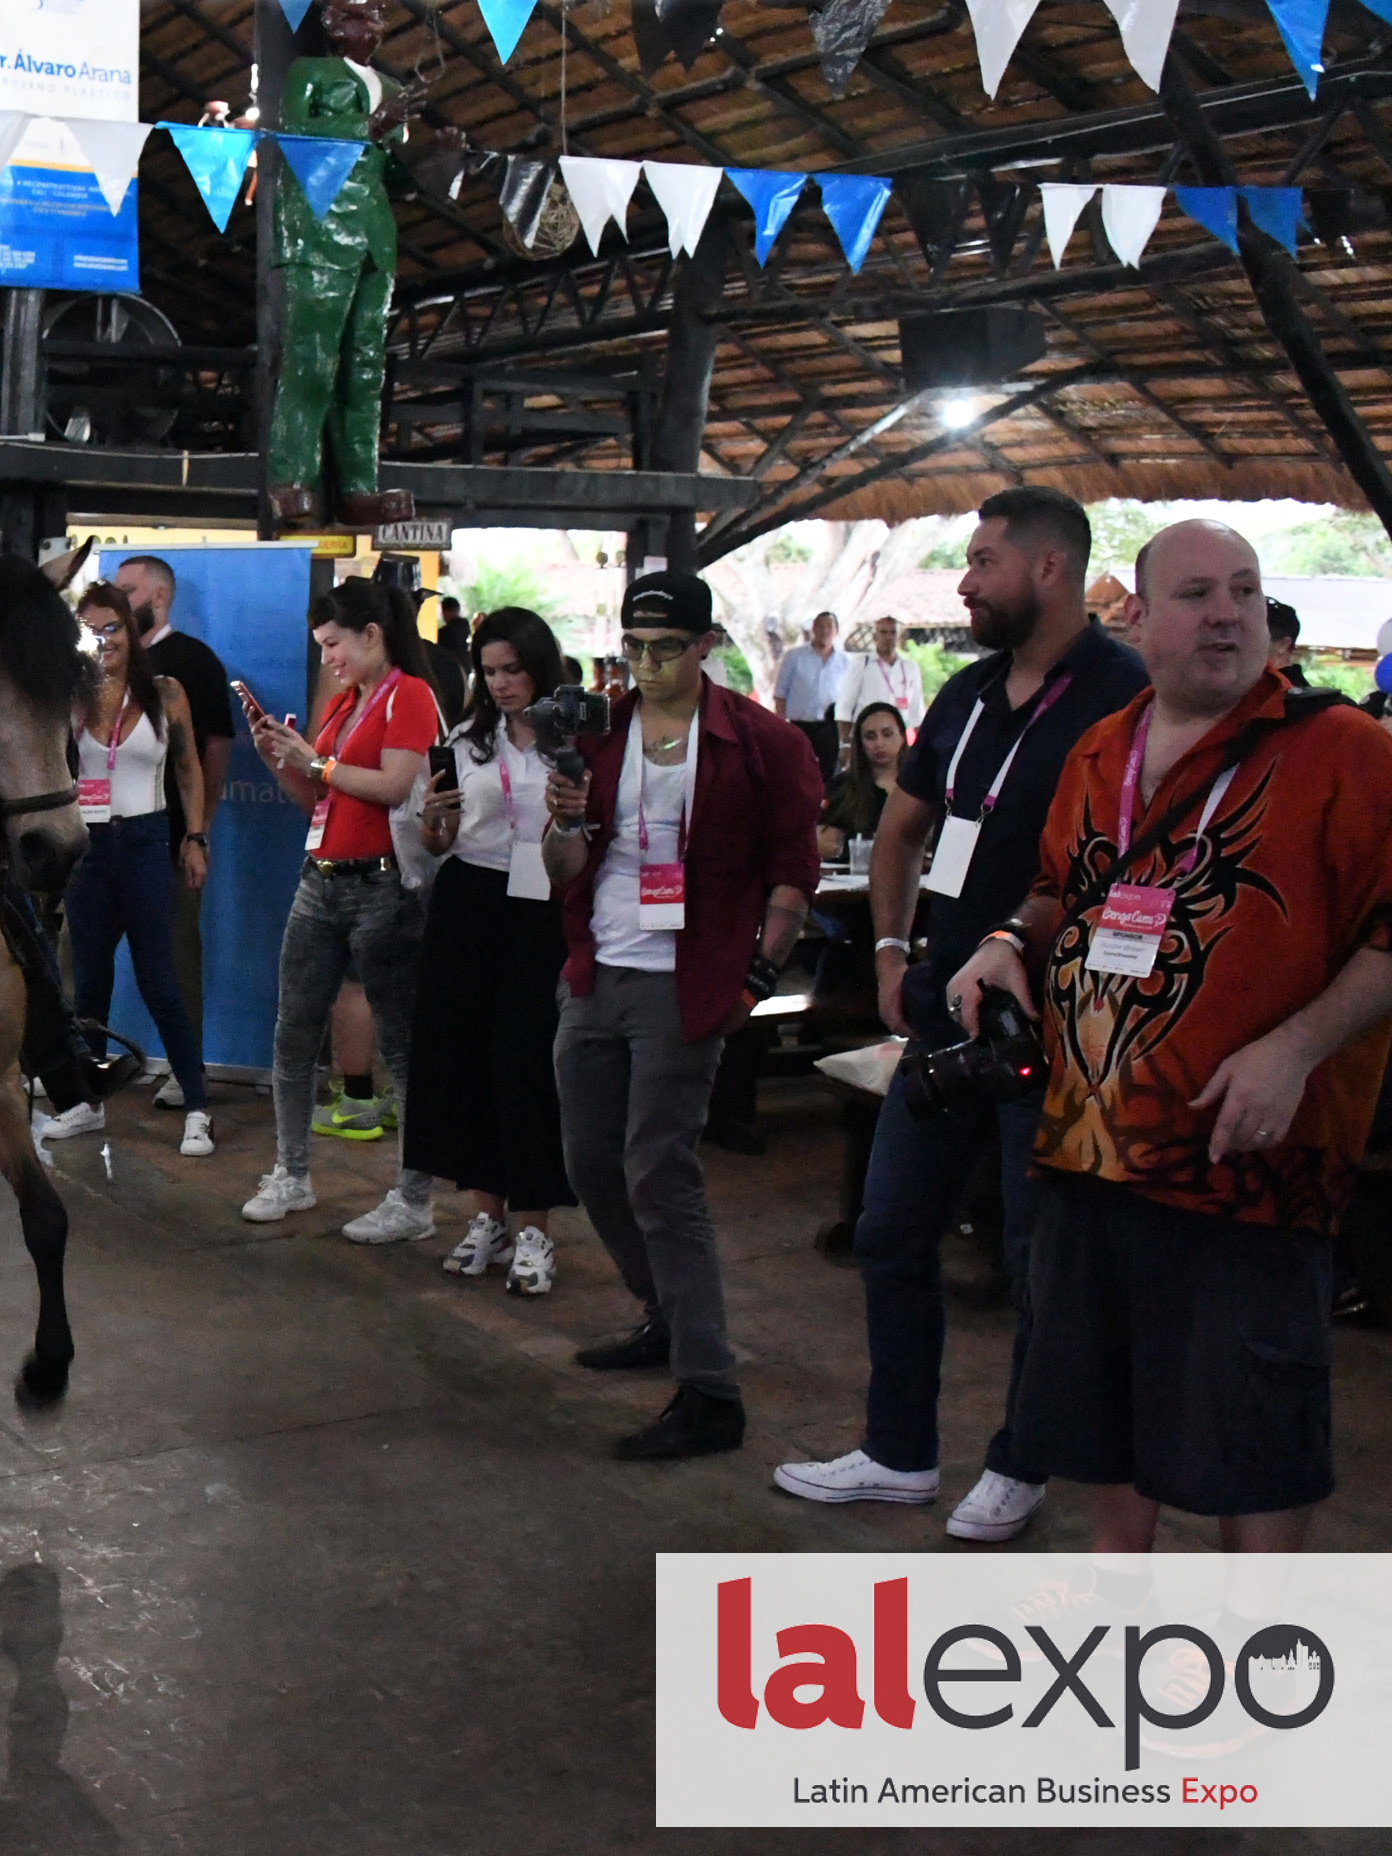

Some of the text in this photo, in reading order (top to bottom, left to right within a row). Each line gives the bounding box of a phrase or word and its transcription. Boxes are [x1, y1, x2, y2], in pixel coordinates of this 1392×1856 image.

[13, 48, 76, 79] Álvaro
[78, 62, 131, 85] Arana
[381, 523, 444, 542] CANTINA
[318, 540, 348, 550] UERRA
